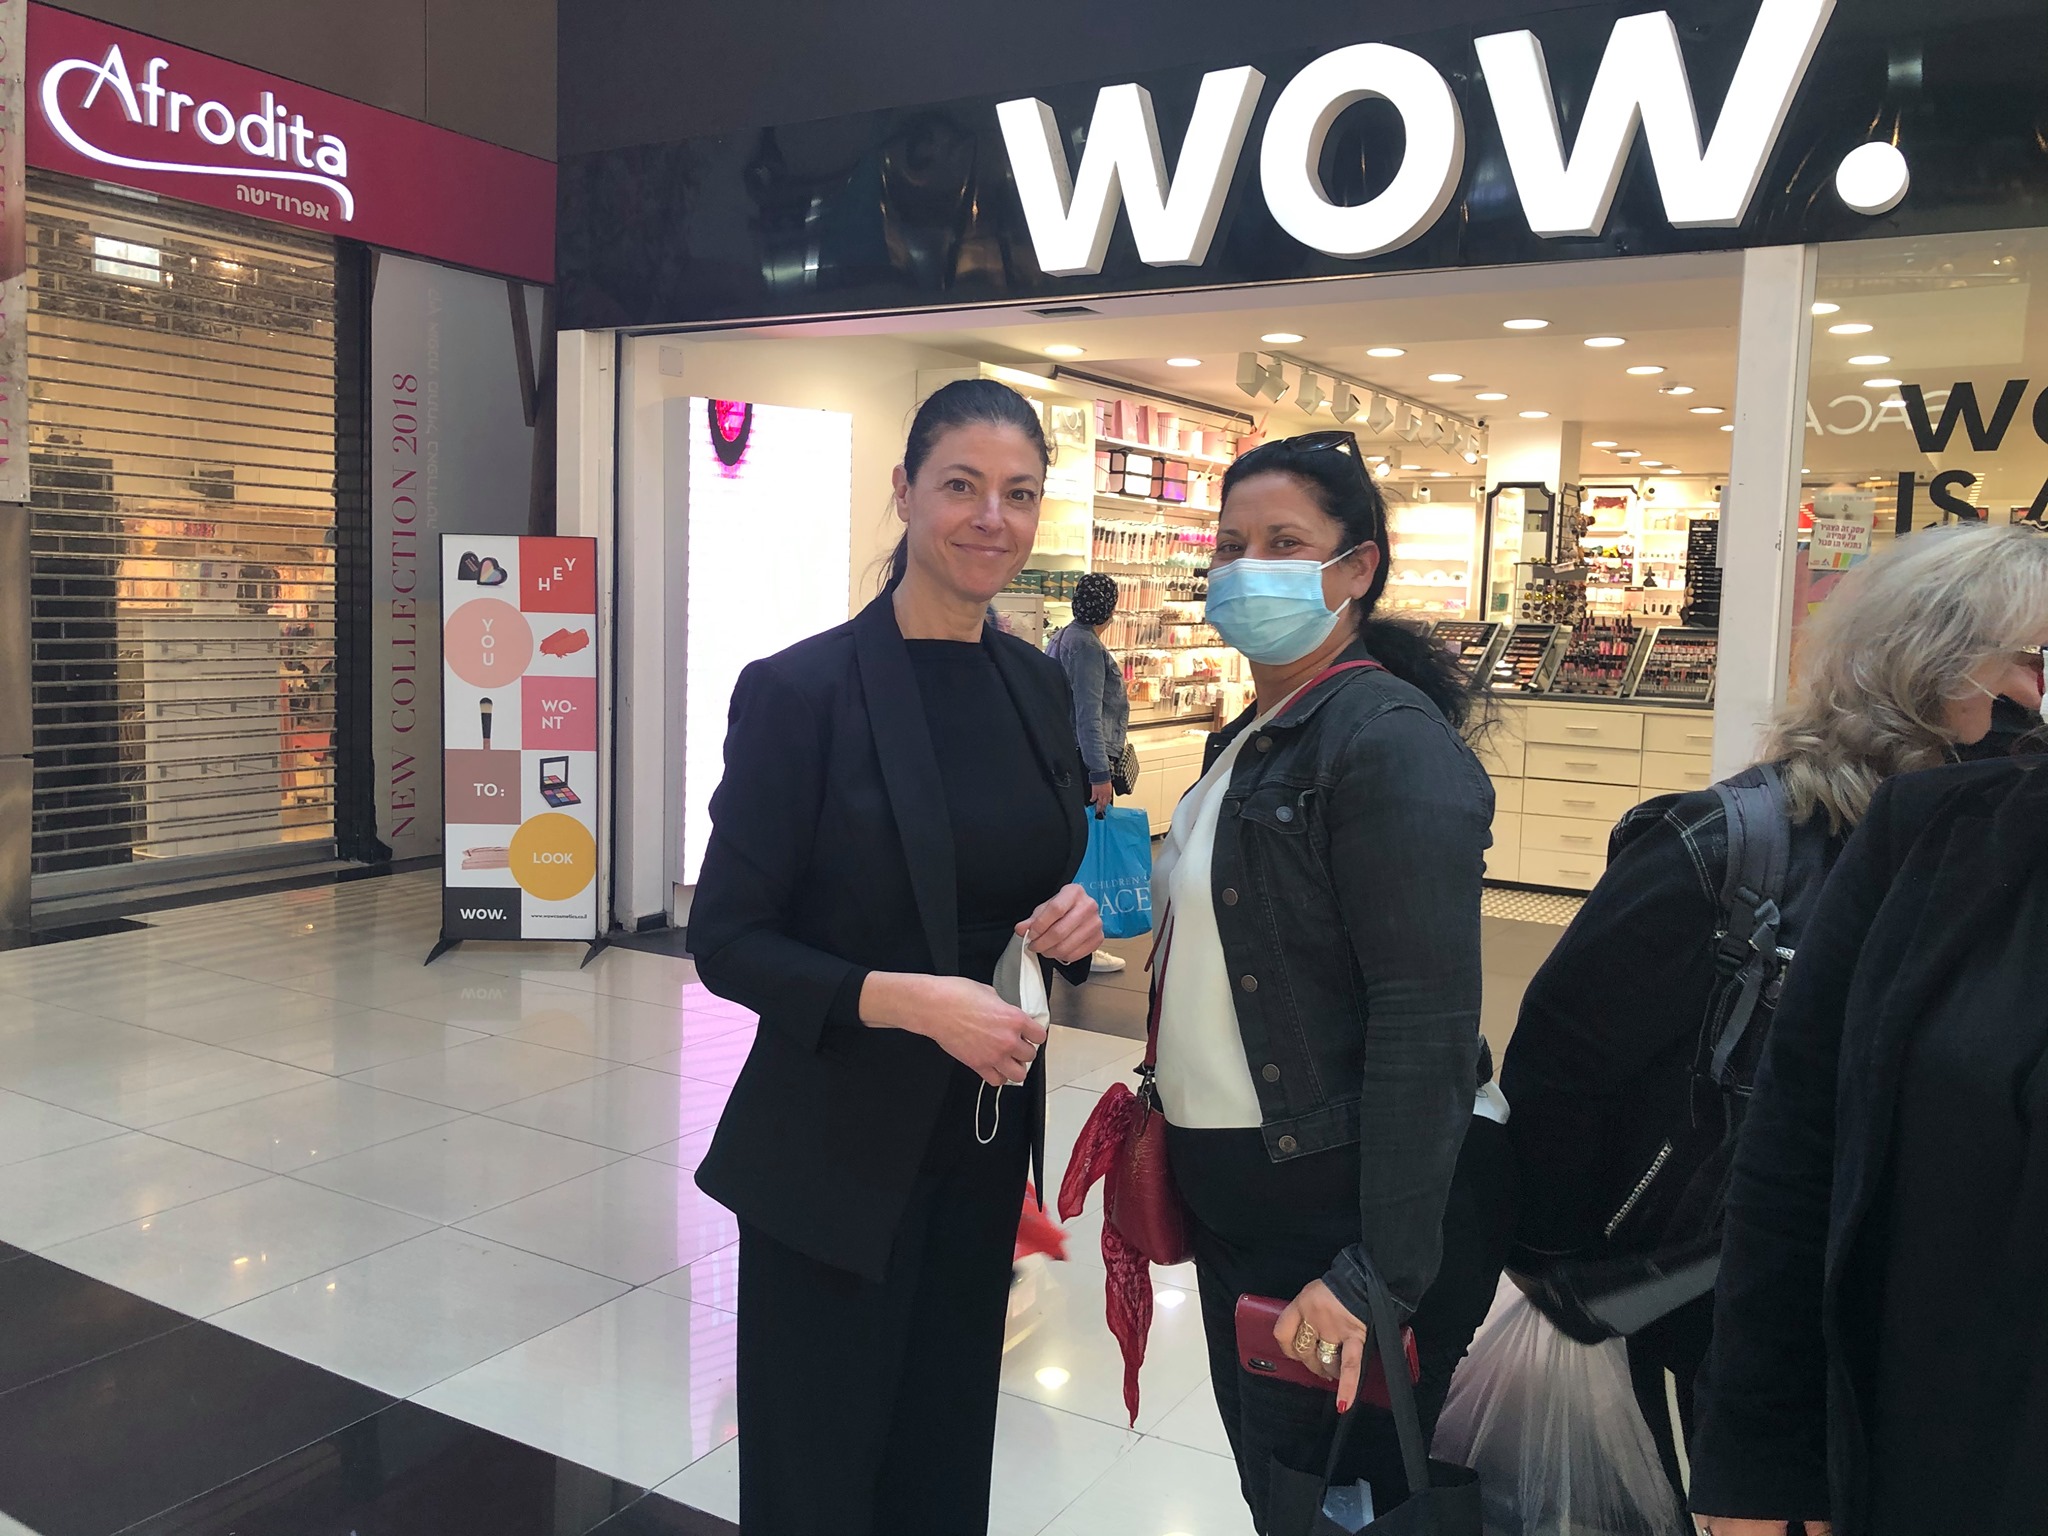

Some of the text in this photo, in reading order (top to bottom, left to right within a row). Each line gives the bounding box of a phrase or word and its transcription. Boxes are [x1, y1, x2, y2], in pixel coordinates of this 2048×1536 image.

[42, 43, 351, 181] Afrodita
[996, 0, 1909, 277] WOW.
[236, 184, 330, 221] אפרודיטה
[425, 382, 440, 435] מתחיל
[1899, 379, 2048, 453] W
[424, 440, 440, 530] באפרודיטה
[538, 557, 576, 591] HEY
[391, 373, 418, 839] NEW COLLECTION 2018
[481, 618, 495, 666] YOU
[541, 699, 577, 714] WO-
[541, 716, 564, 730] NT
[473, 783, 505, 797] TO:
[533, 852, 573, 865] LOOK
[460, 908, 507, 920] WOW.
